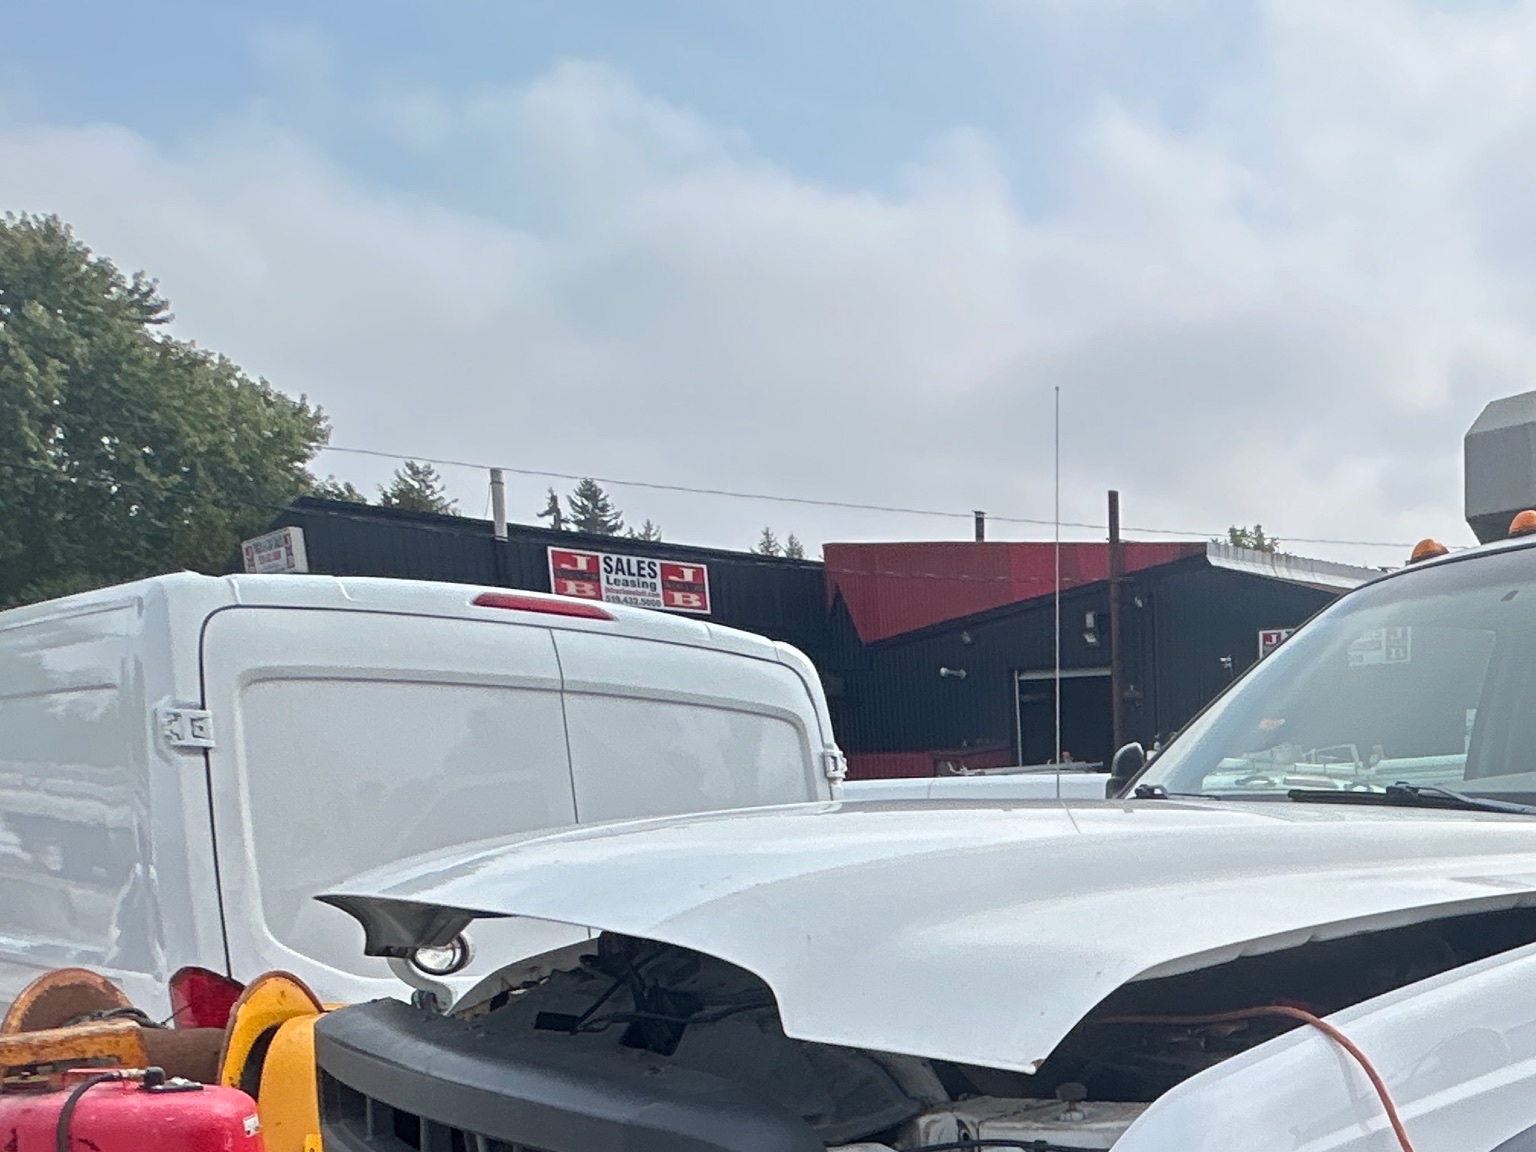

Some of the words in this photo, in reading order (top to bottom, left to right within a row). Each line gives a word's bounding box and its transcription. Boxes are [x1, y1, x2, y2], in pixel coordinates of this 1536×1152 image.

[560, 554, 591, 570] J
[603, 555, 658, 579] SALES
[605, 574, 657, 592] Leasing
[668, 567, 697, 582] J
[561, 578, 597, 597] B
[668, 591, 702, 607] B
